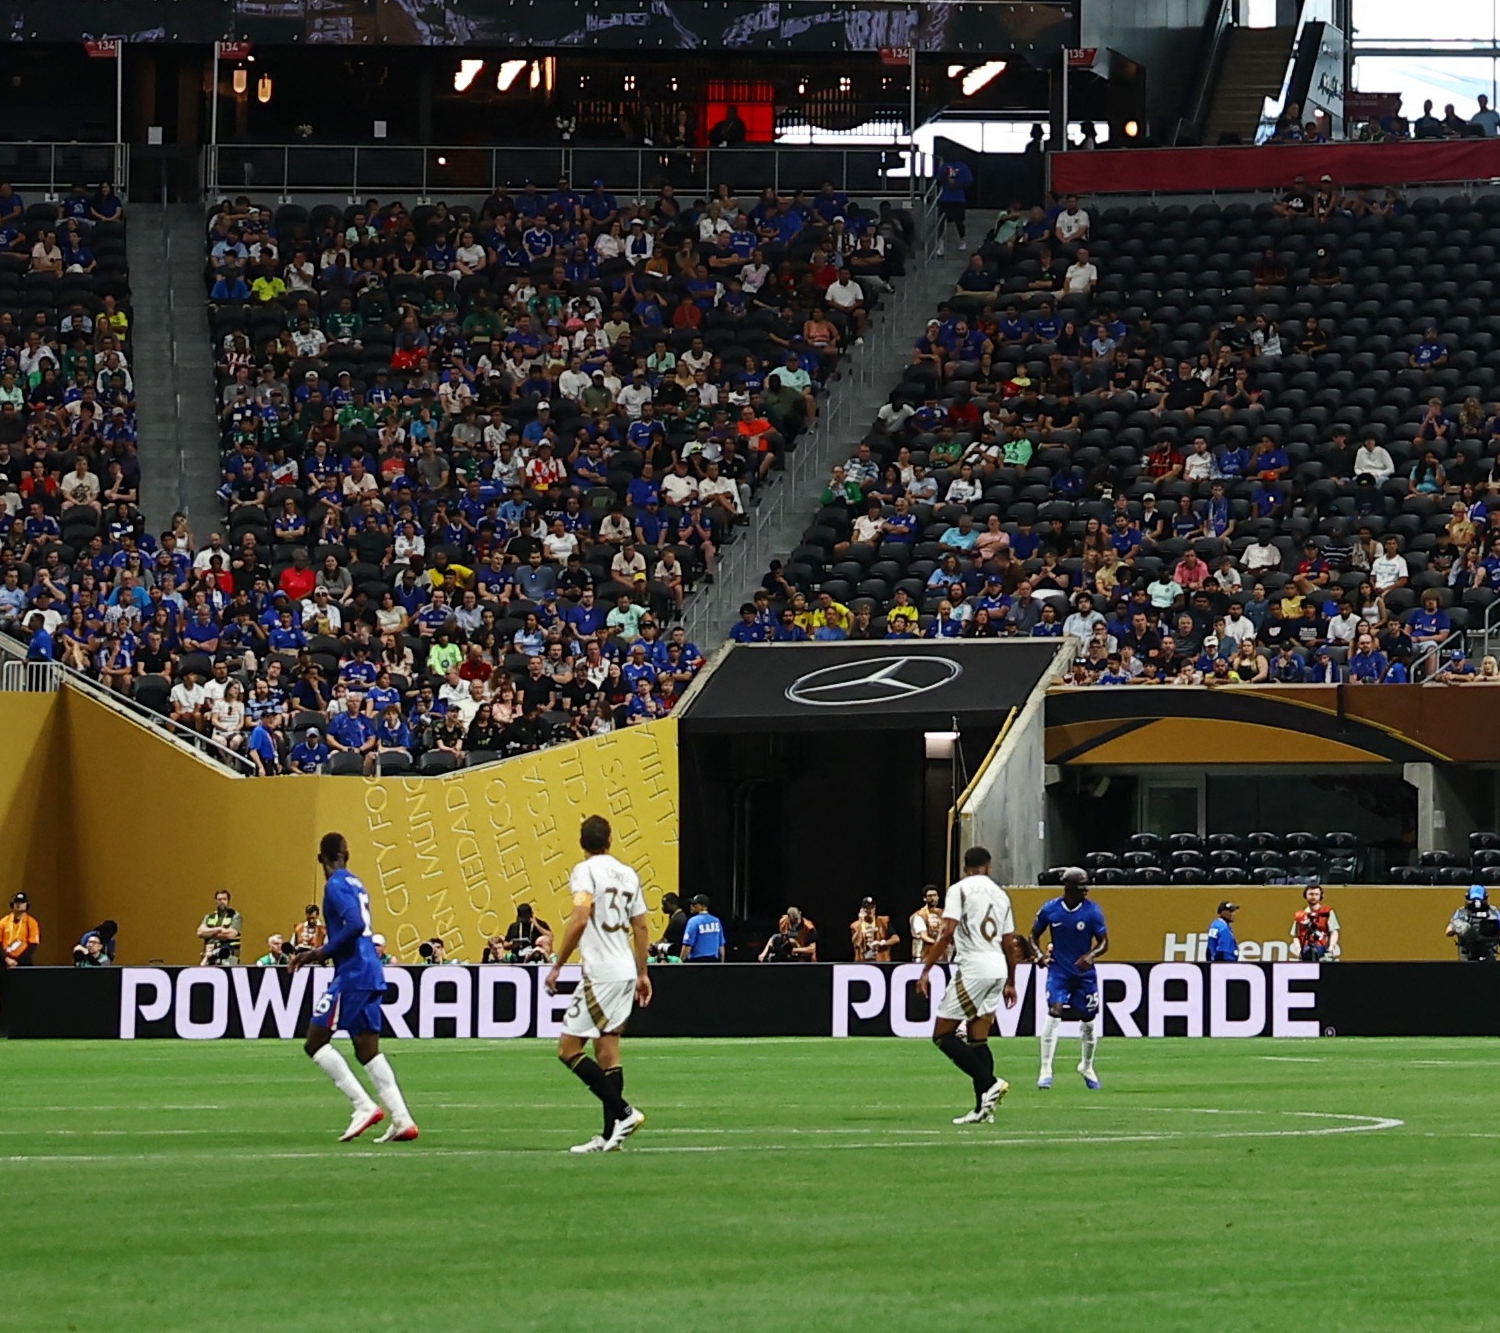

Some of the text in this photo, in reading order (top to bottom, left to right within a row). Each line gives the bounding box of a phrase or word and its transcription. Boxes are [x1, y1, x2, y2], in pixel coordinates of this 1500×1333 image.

[96, 39, 116, 51] 134
[220, 40, 241, 52] 134
[891, 46, 910, 59] 134
[601, 886, 635, 933] 33
[979, 902, 999, 943] 6
[120, 966, 580, 1040] POWRADE
[832, 963, 1321, 1038] PORADE
